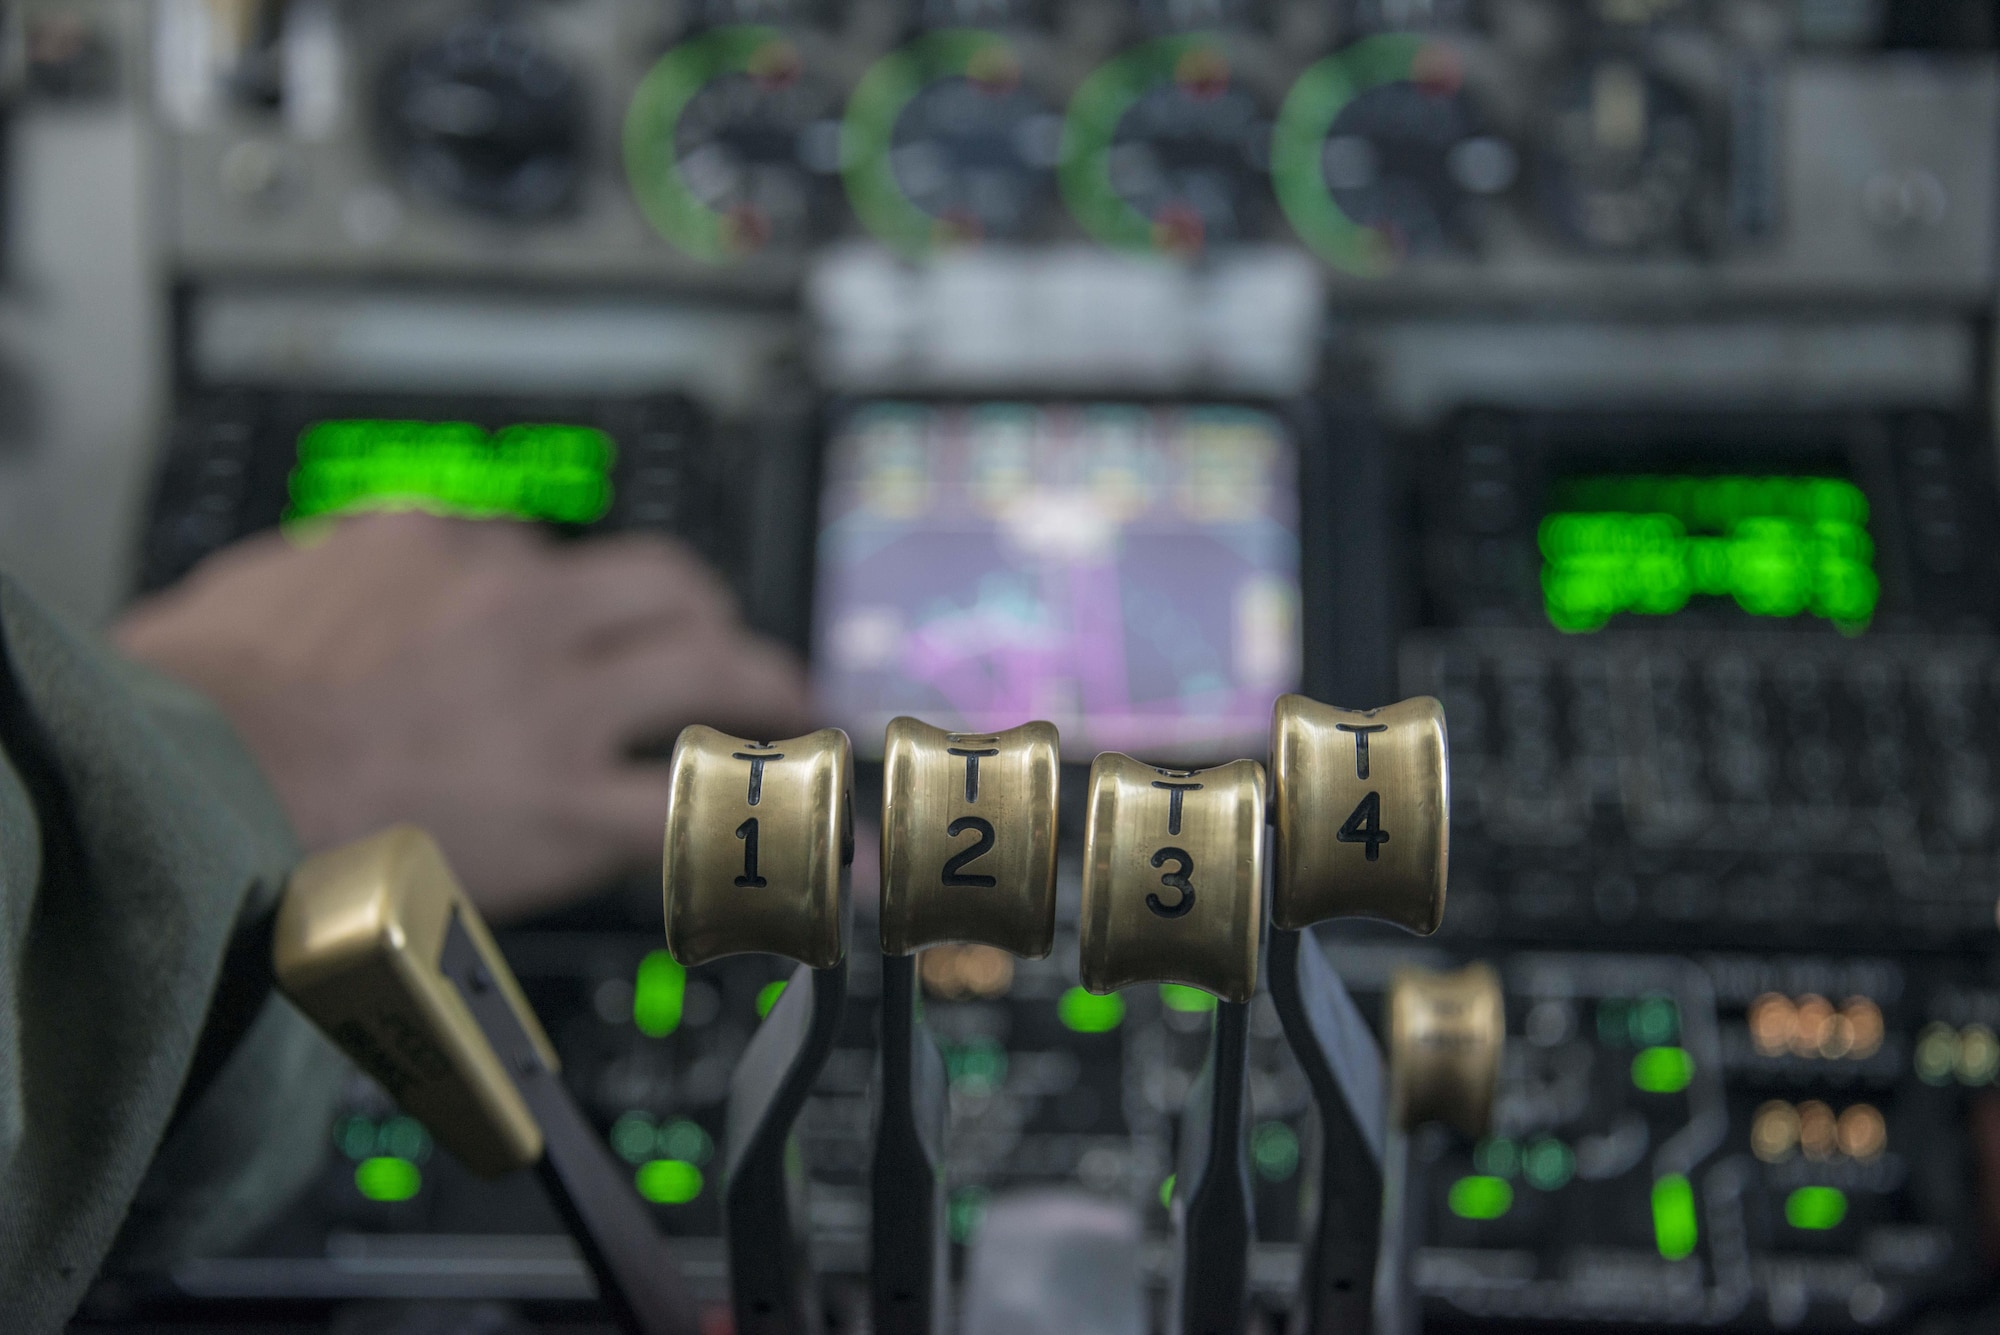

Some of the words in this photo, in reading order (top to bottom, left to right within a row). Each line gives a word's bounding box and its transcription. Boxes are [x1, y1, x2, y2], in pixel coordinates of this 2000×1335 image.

[734, 817, 767, 888] 1
[941, 816, 996, 887] 2
[1337, 791, 1390, 862] 4
[1145, 846, 1195, 919] 3
